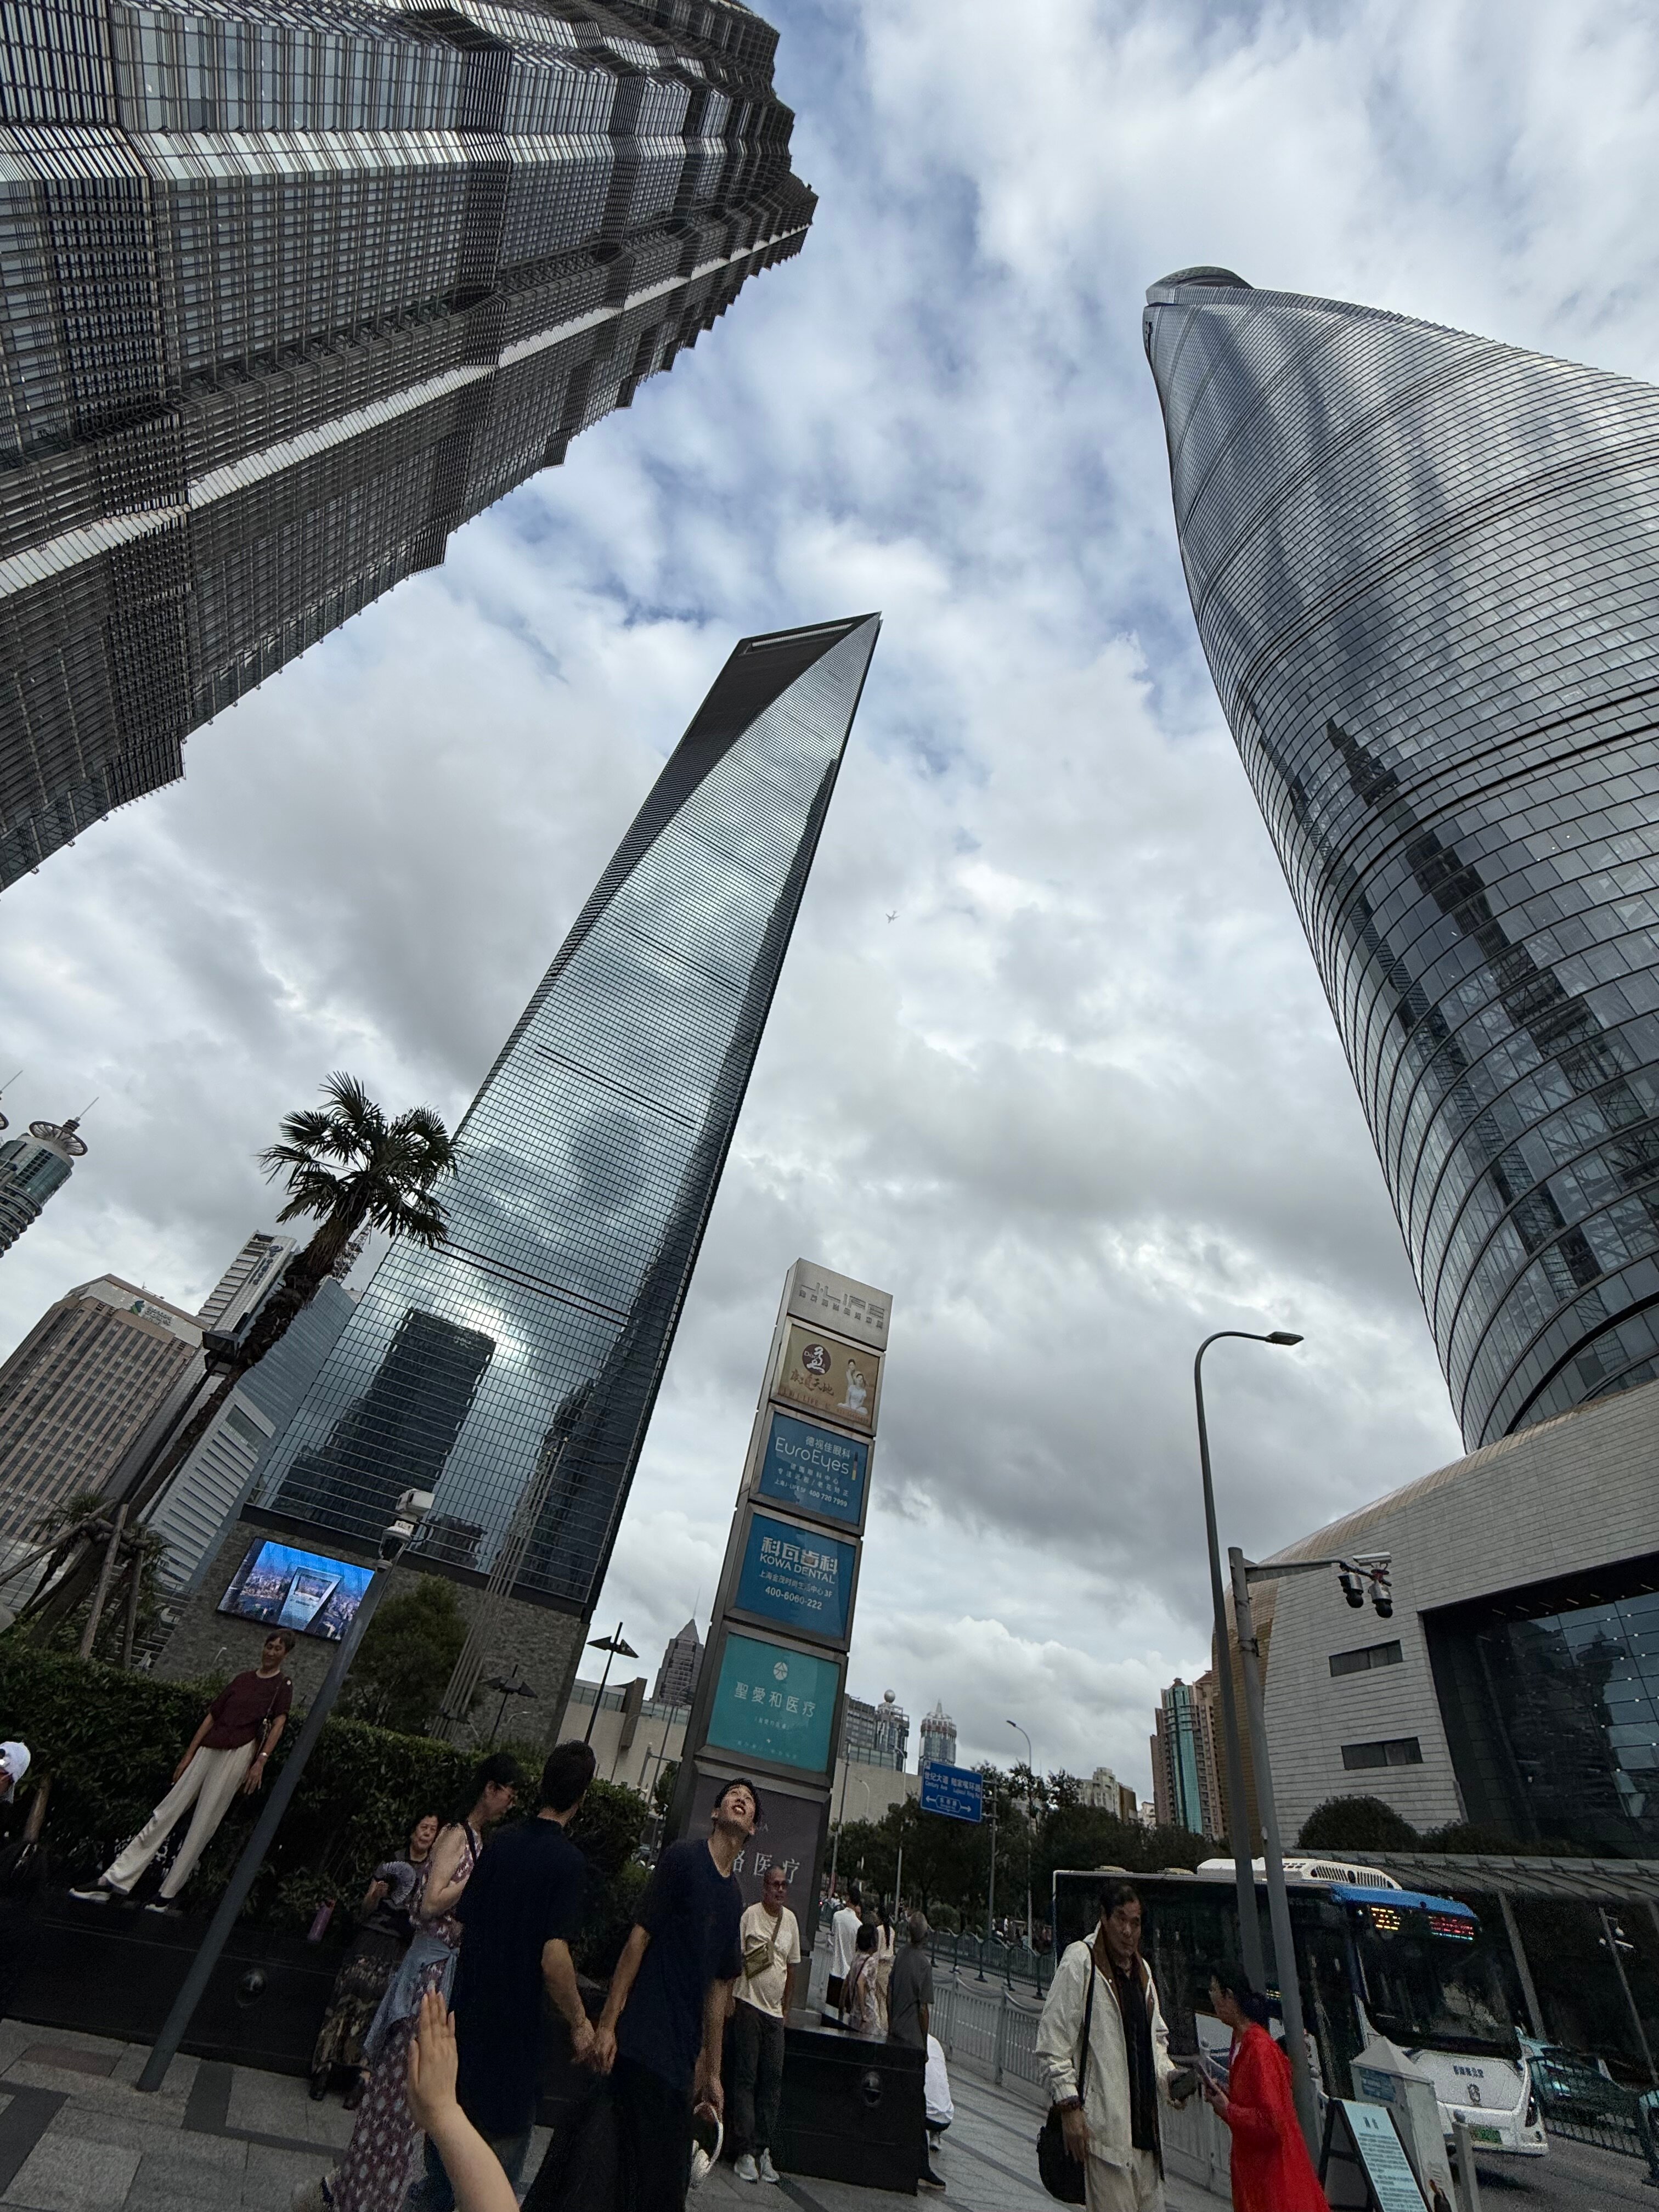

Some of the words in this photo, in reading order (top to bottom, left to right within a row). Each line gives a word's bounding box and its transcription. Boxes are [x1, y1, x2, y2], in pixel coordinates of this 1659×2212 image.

[775, 1436, 850, 1475] EuroEyes
[759, 1553, 792, 1571] KOWA
[793, 1564, 836, 1585] DENTAL
[761, 1536, 838, 1575] 科瓦齿科
[765, 1585, 823, 1610] 400-6060-222
[734, 1681, 816, 1718] 聖愛和医疗
